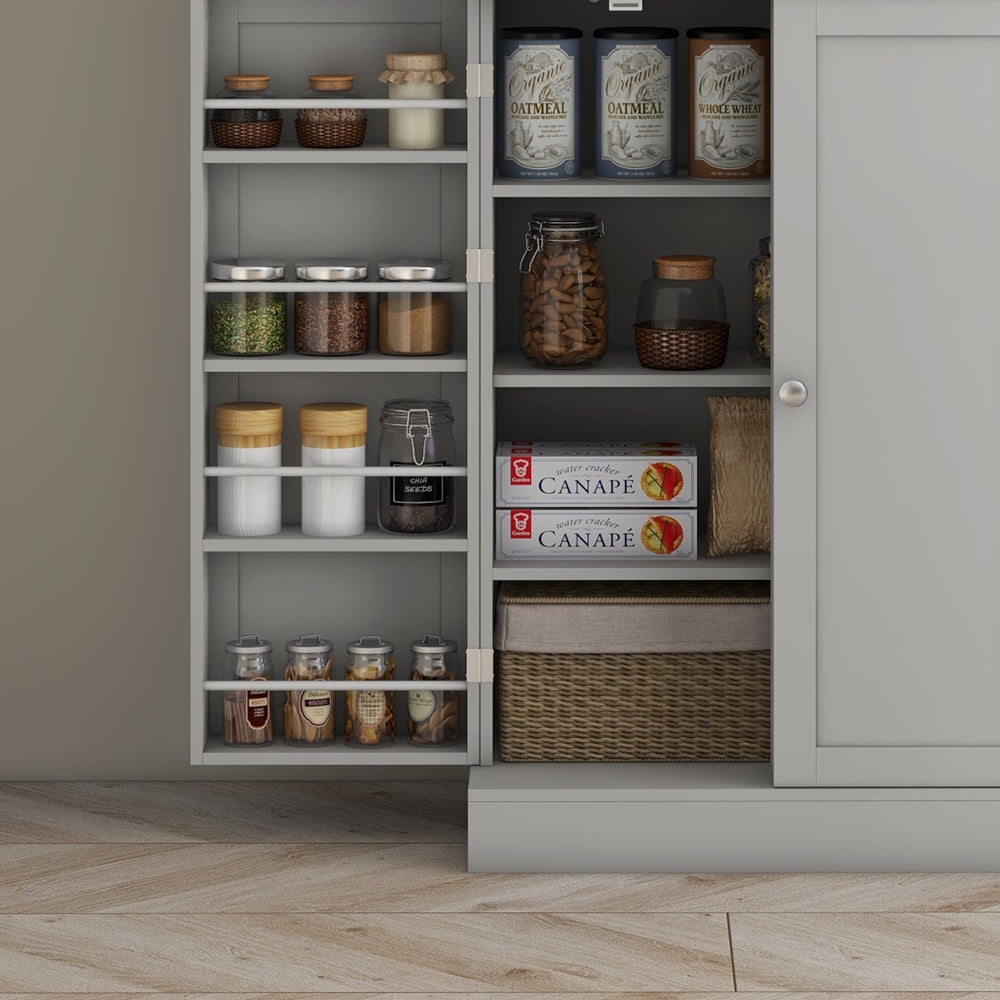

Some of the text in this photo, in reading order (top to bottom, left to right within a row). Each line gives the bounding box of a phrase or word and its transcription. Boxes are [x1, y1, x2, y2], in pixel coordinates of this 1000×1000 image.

[509, 59, 567, 100] Organic
[605, 59, 664, 100] Organic
[699, 58, 757, 101] Organic
[511, 102, 568, 115] OATMEAL
[607, 102, 665, 115] OATMEAL
[698, 103, 762, 115] WHOLE WHEAT
[556, 464, 620, 476] water cracker
[404, 485, 433, 493] SEEDS
[538, 474, 635, 494] CANAPÉ
[556, 518, 620, 529] water cracker
[538, 528, 635, 548] CANAPÉ
